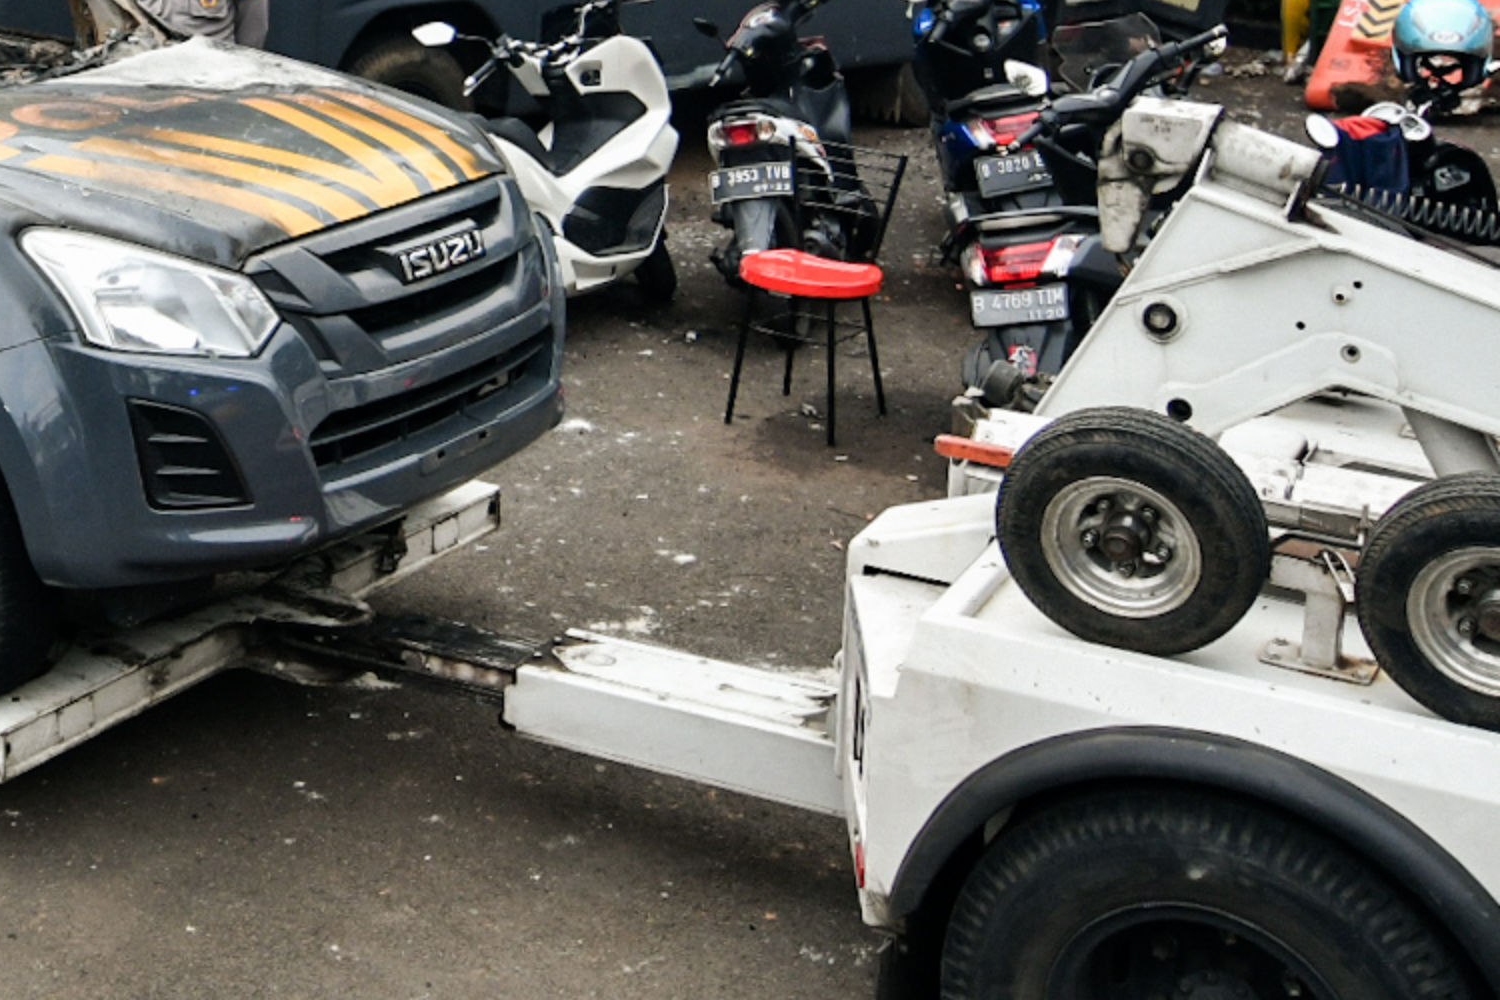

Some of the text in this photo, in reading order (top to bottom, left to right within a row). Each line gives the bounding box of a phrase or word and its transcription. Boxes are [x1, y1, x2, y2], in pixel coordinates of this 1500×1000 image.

[400, 229, 485, 281] ISUZU
[973, 288, 1065, 313] B 4769 TIM
